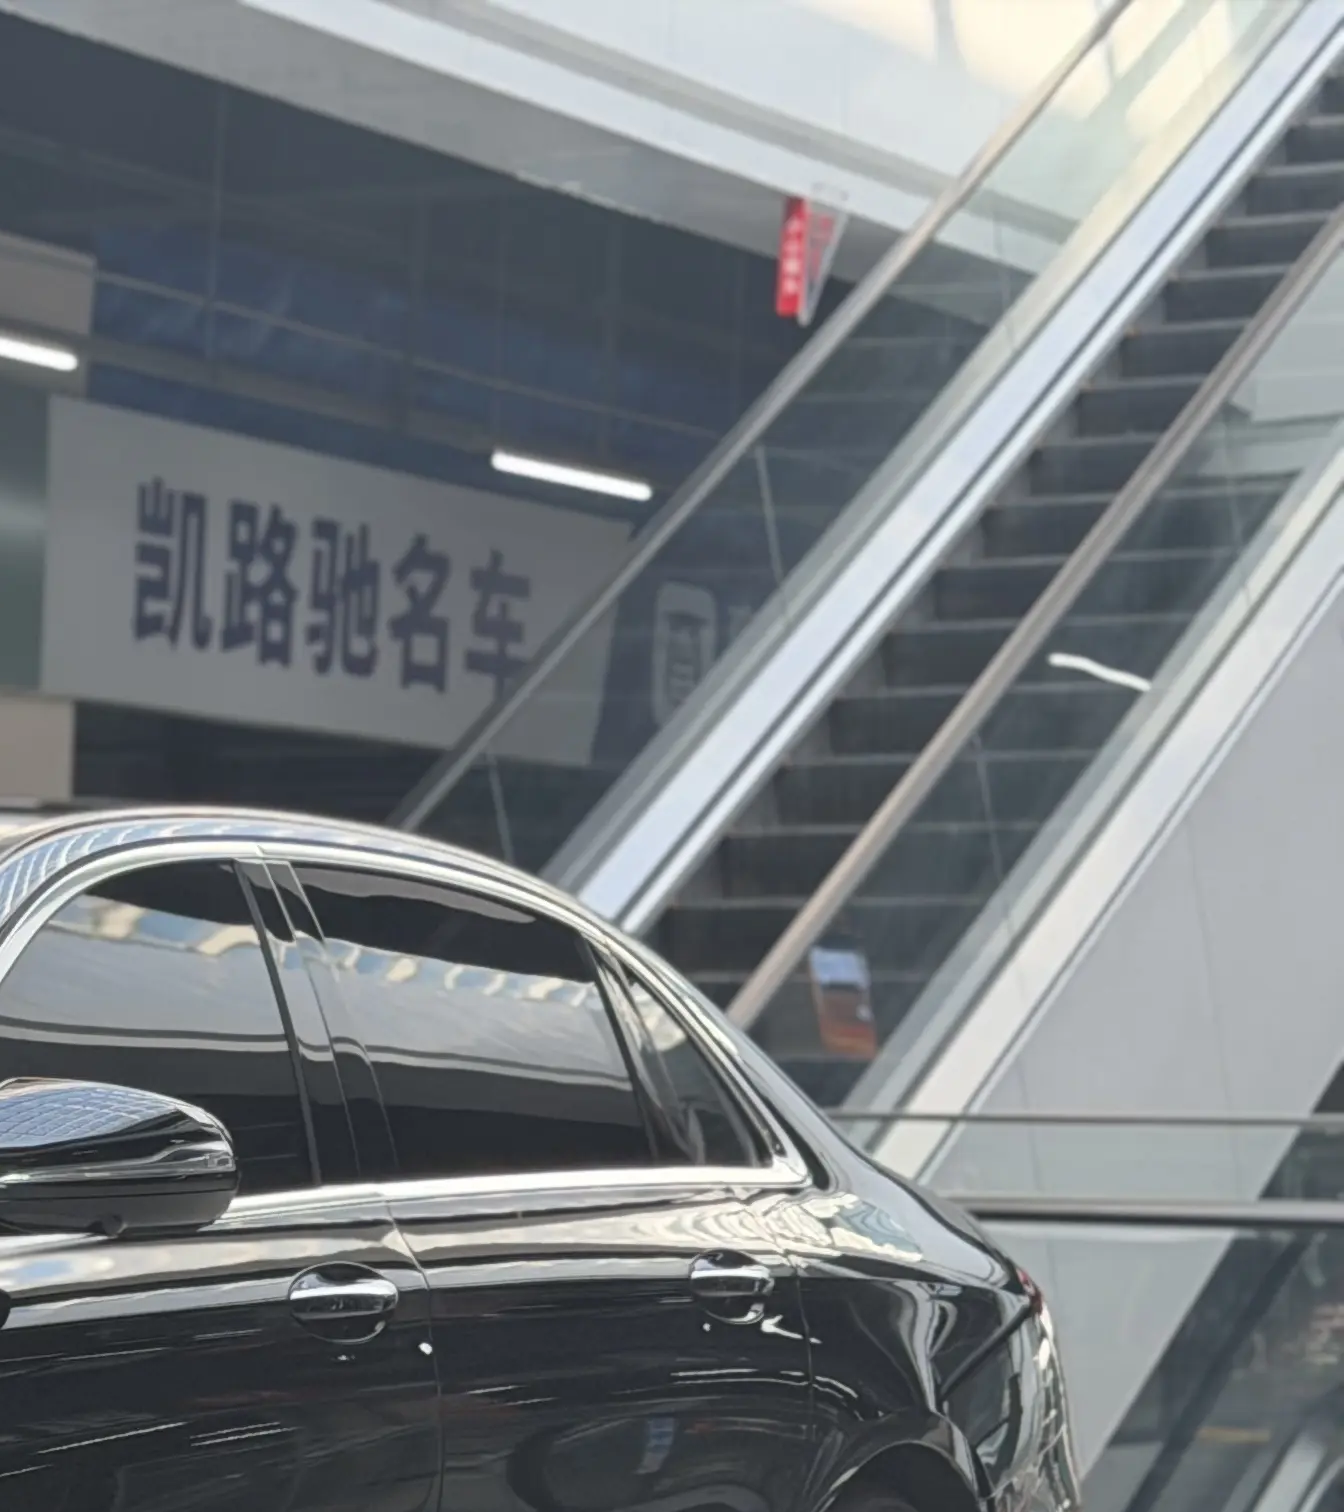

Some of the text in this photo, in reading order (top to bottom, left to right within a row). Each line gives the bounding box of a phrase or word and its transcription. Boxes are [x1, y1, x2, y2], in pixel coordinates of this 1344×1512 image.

[131, 475, 531, 702] 凯路驰名车
